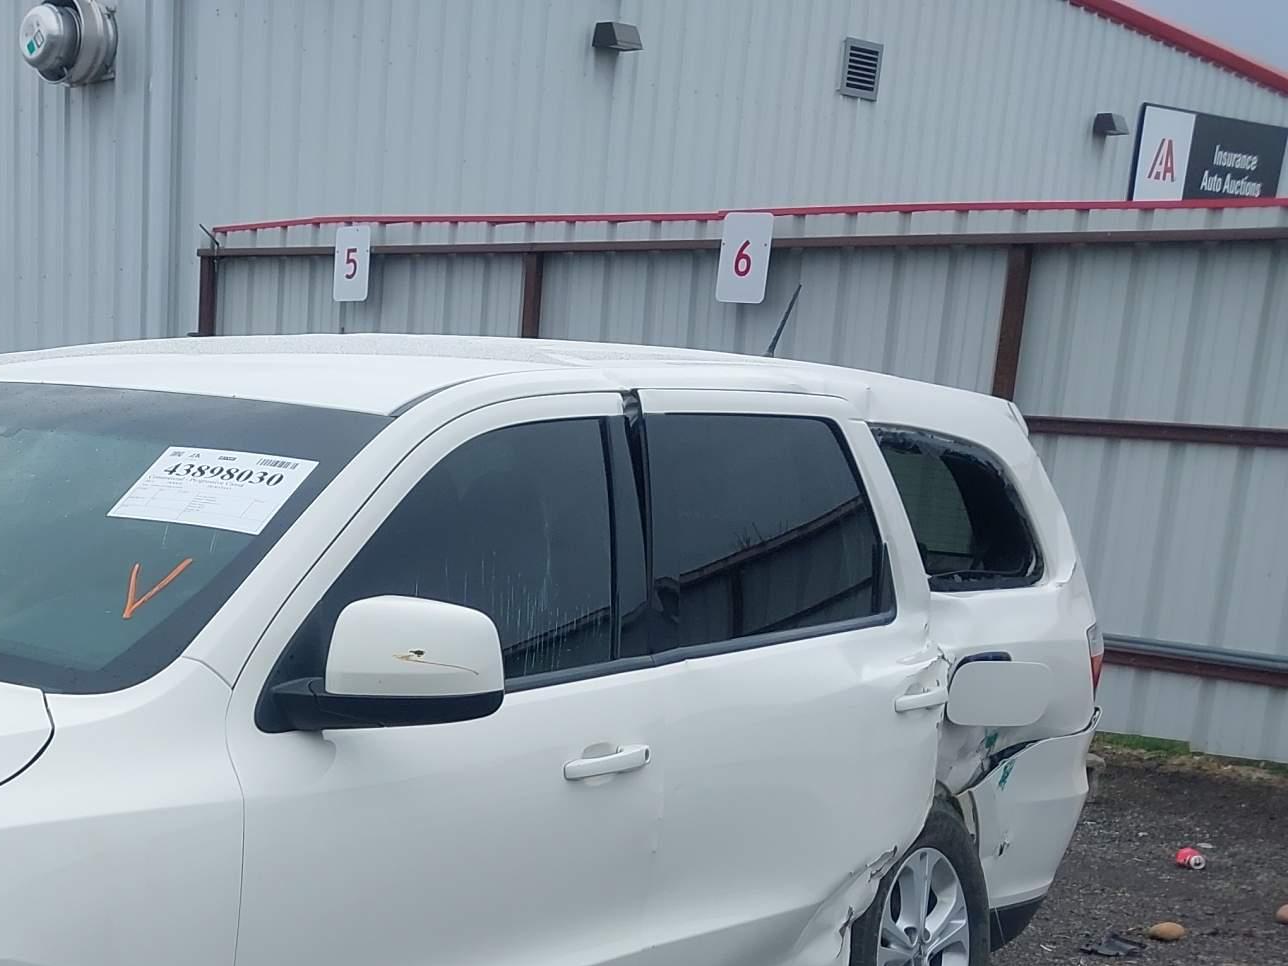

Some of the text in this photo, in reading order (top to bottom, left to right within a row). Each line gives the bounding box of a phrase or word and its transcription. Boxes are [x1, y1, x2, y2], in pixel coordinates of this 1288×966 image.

[1213, 144, 1258, 171] Insurance
[1200, 170, 1262, 198] Auto Auctions
[345, 247, 358, 280] 5
[734, 240, 752, 277] 6
[163, 462, 285, 487] 43898030
